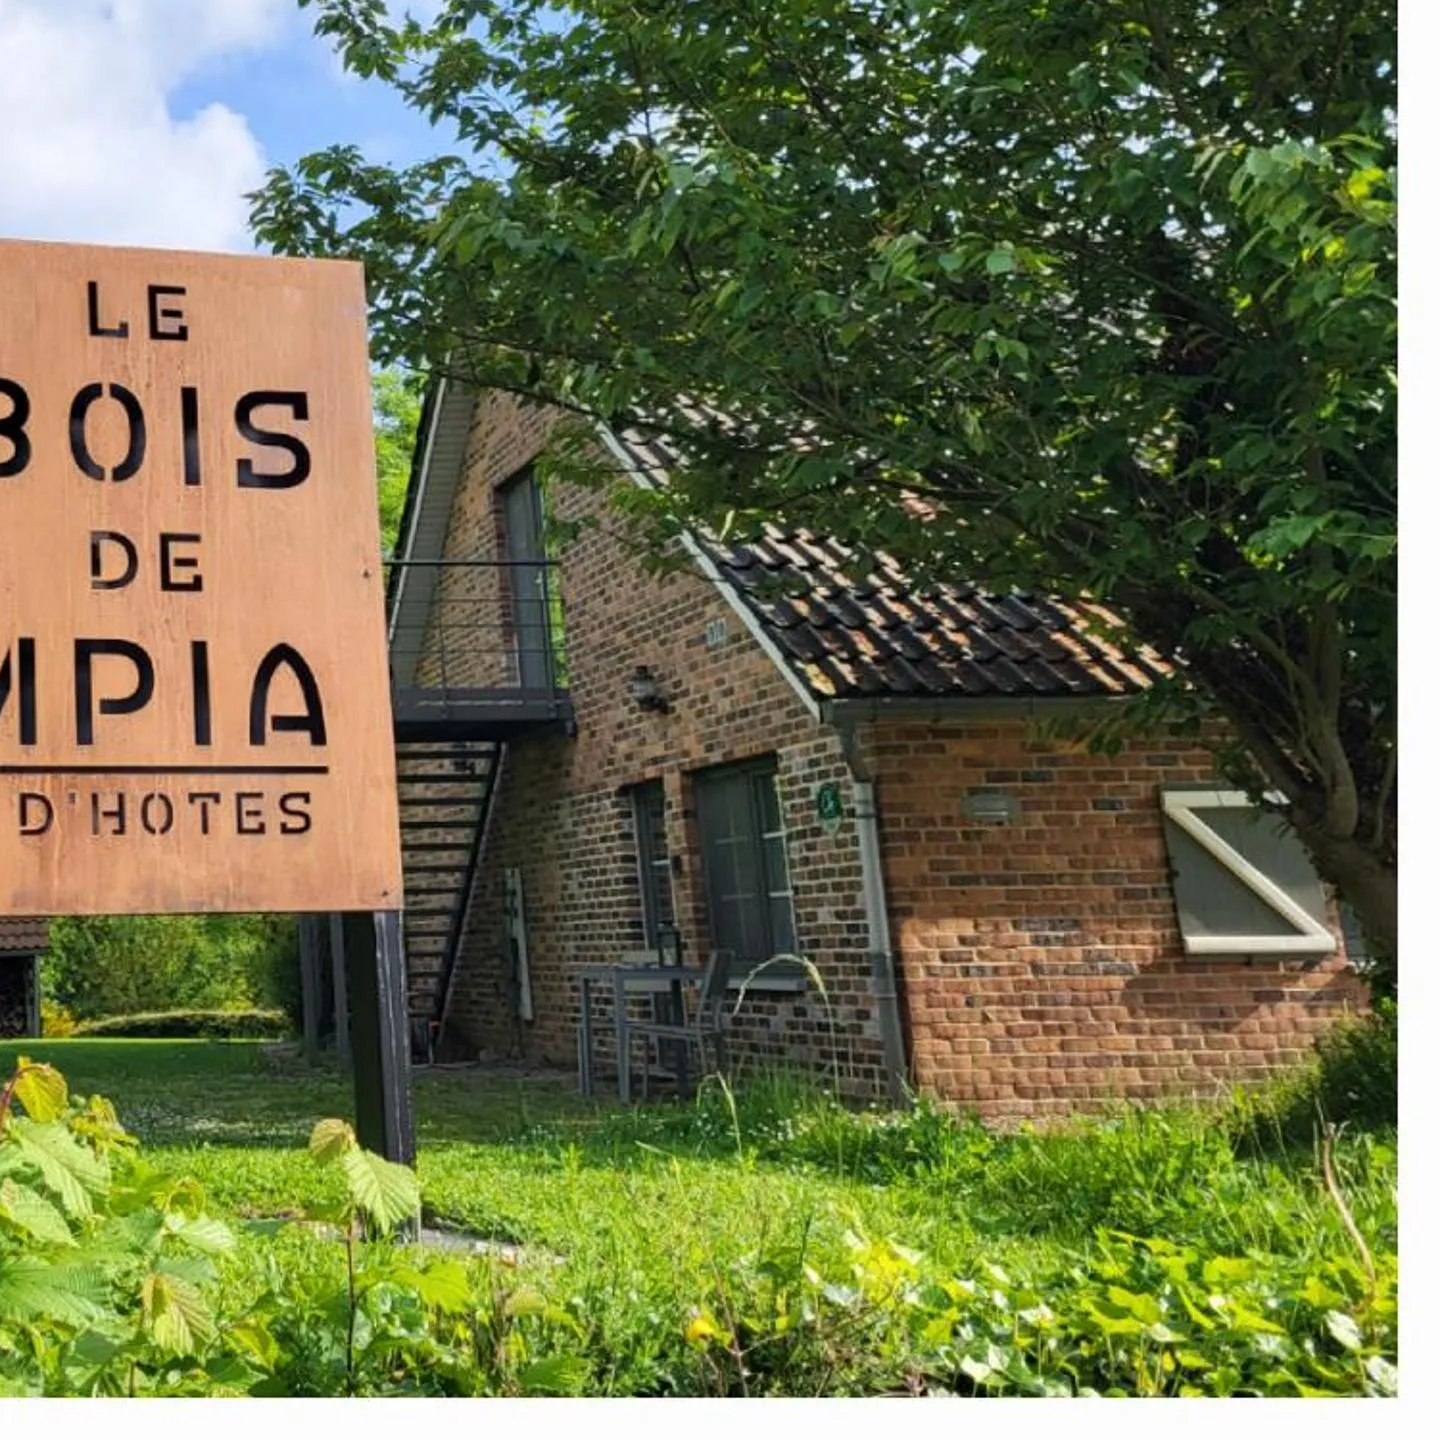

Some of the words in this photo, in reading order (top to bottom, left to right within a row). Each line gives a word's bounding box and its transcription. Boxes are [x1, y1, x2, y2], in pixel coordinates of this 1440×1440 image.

[88, 281, 189, 342] LE
[91, 532, 203, 593] DE
[20, 793, 312, 836] D'HOTES
